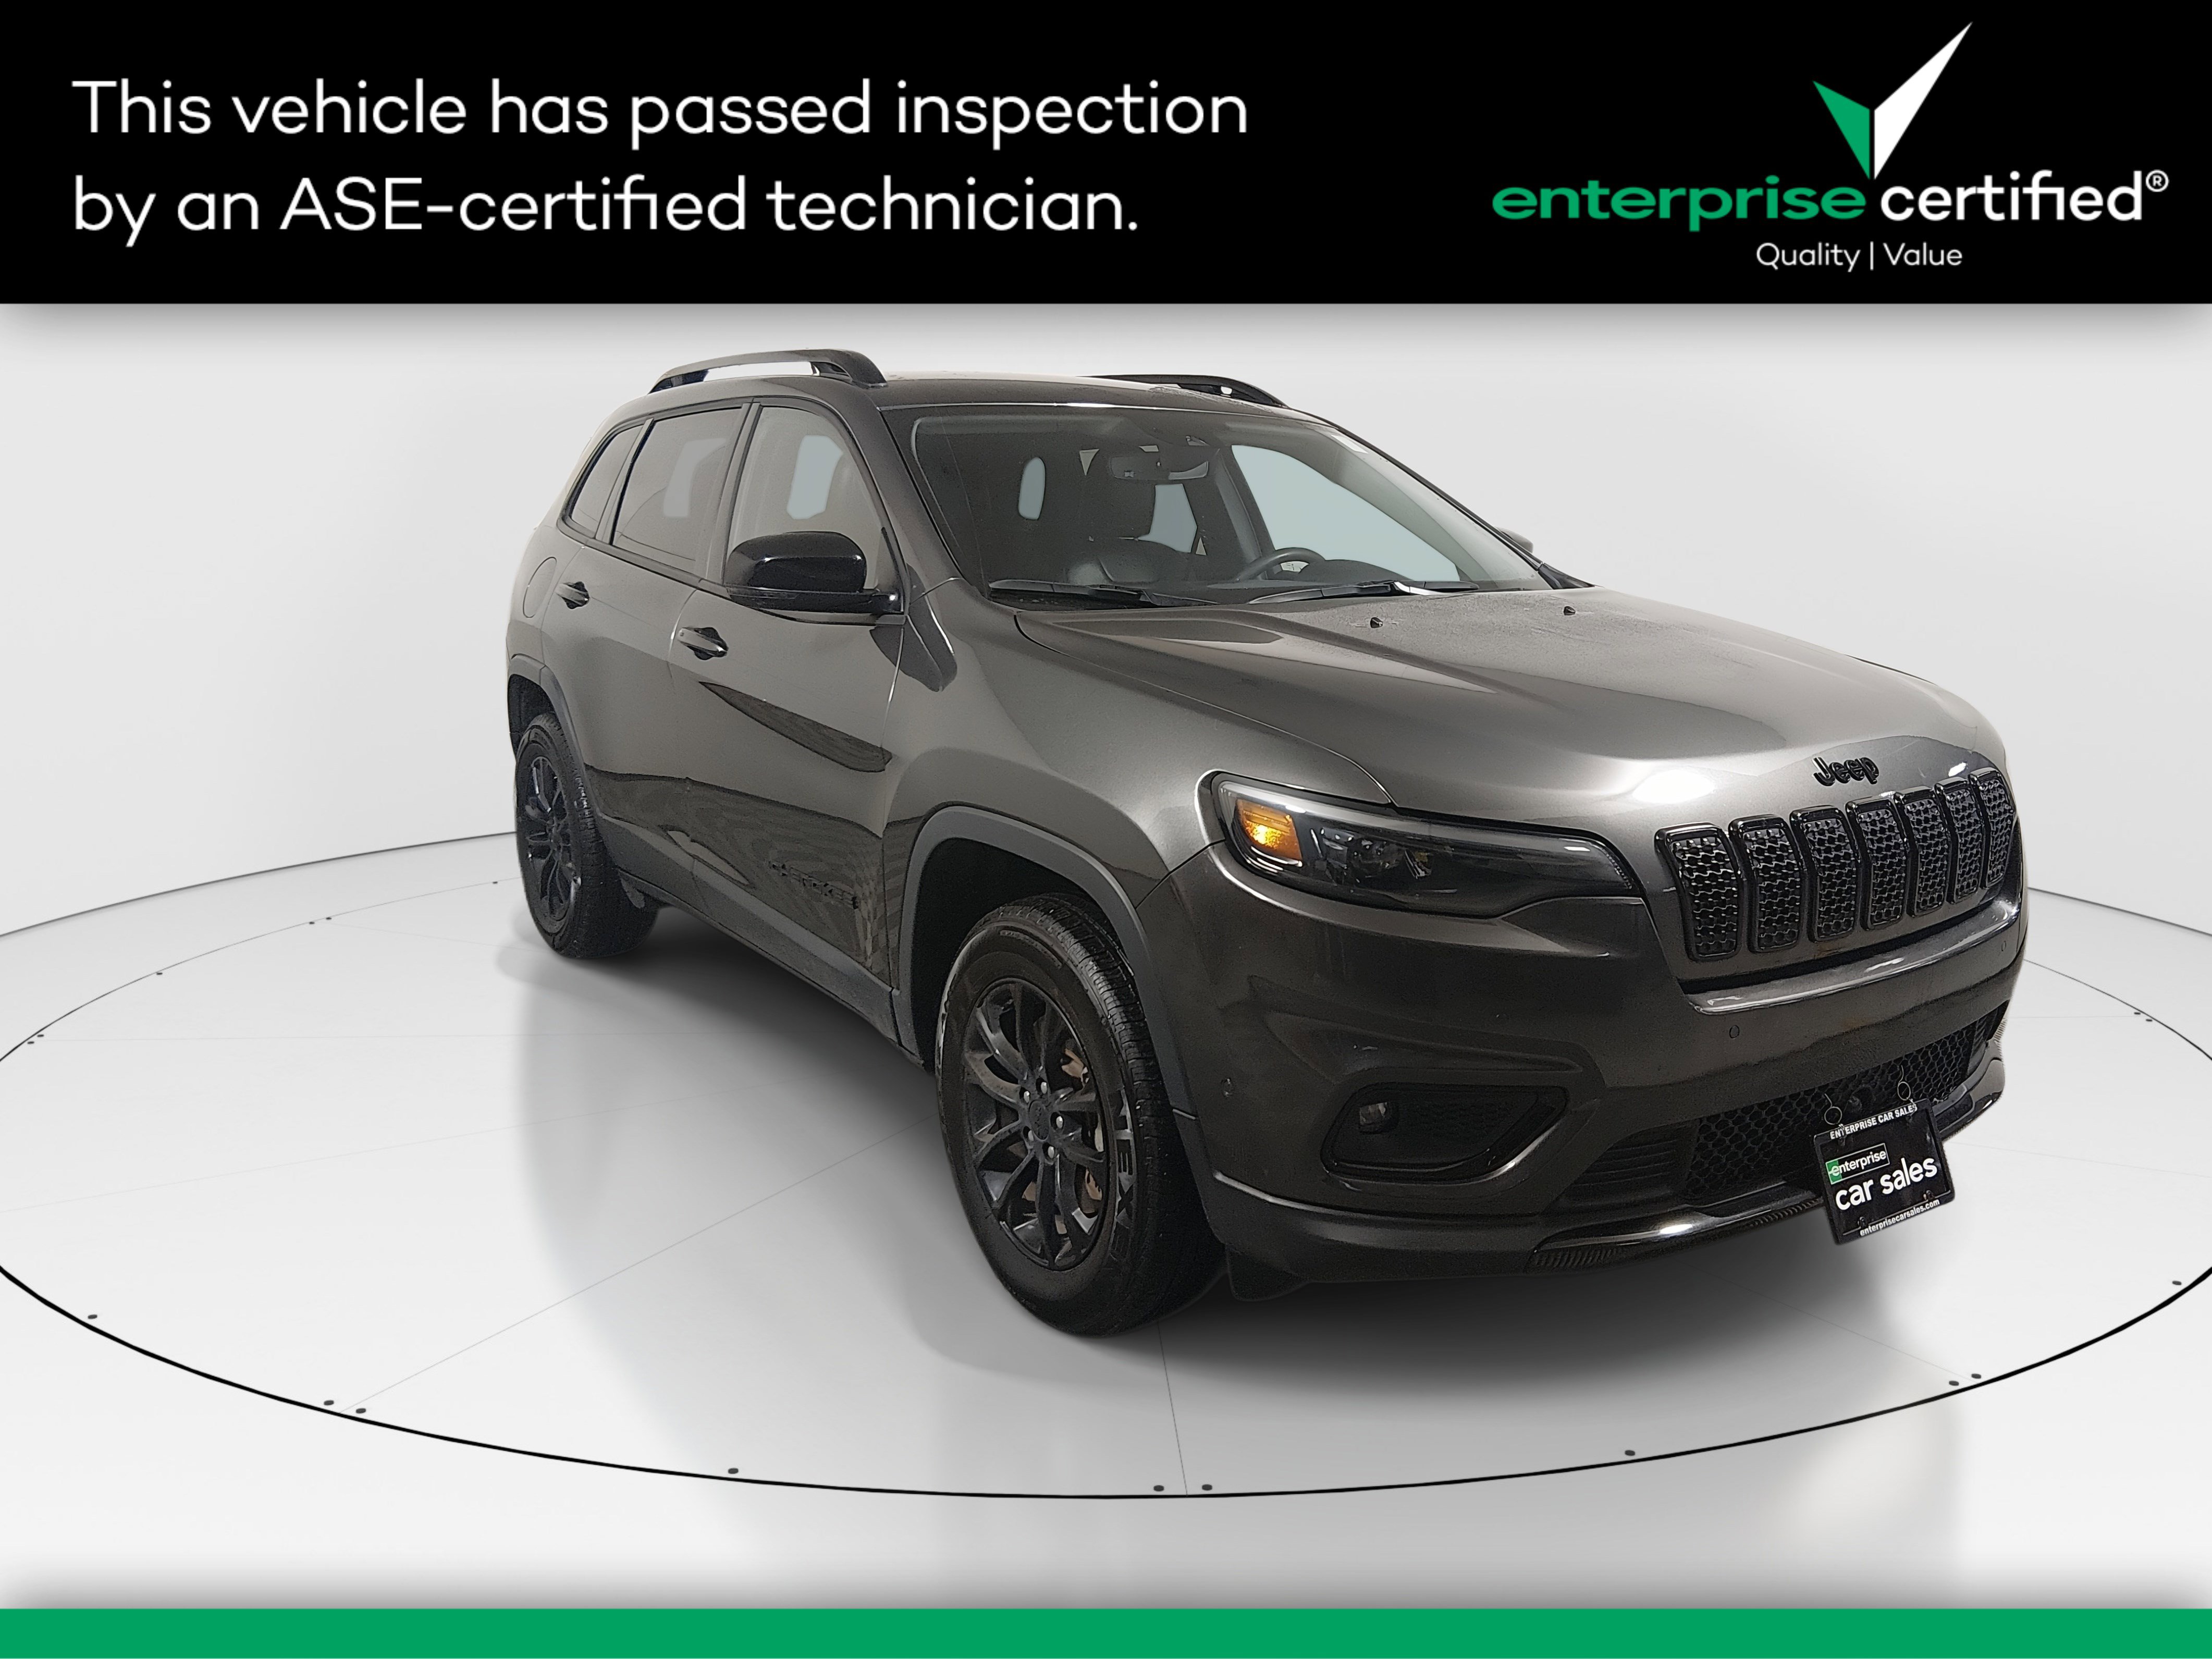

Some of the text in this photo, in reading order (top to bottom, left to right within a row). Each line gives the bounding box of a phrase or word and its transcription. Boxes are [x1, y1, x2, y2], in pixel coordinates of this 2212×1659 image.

[1812, 757, 1879, 786] Jeep
[1830, 1104, 1918, 1139] ENTERPRISE CAR SALES
[1830, 1151, 1886, 1176] enterprise
[1836, 1158, 1937, 1210] car sales
[1860, 1199, 1940, 1236] enterprisecarsales.com
